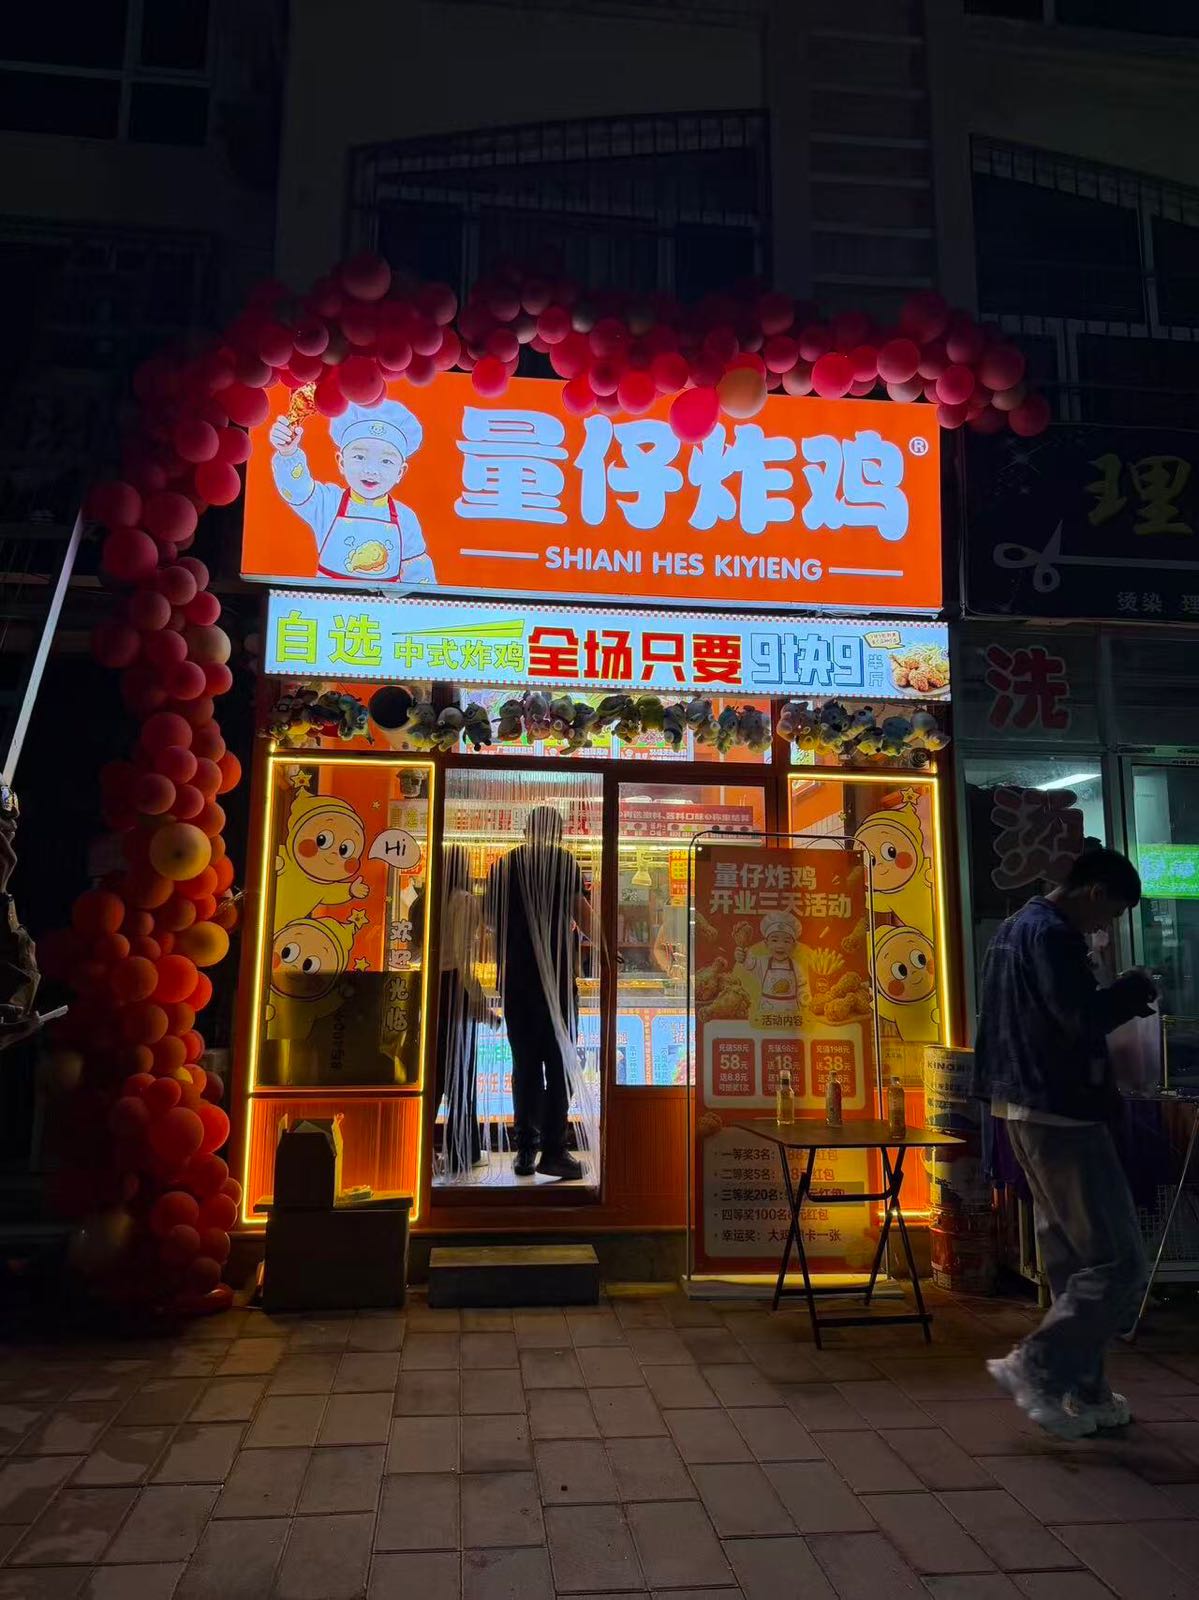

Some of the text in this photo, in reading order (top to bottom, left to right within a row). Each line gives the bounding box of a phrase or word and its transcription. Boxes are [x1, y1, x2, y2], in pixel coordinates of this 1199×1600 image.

[455, 405, 911, 541] 量仔炸鸡
[545, 545, 823, 581] SHIANI HES KIYIENG
[275, 609, 864, 687] 自选 中式炸鸡 全场只要 9块9
[385, 838, 406, 857] Hi
[714, 862, 817, 890] 量仔炸鸡
[710, 890, 852, 918] 开业三天活动
[385, 918, 413, 1032] 欢迎光临
[762, 1014, 803, 1027] 活动内容
